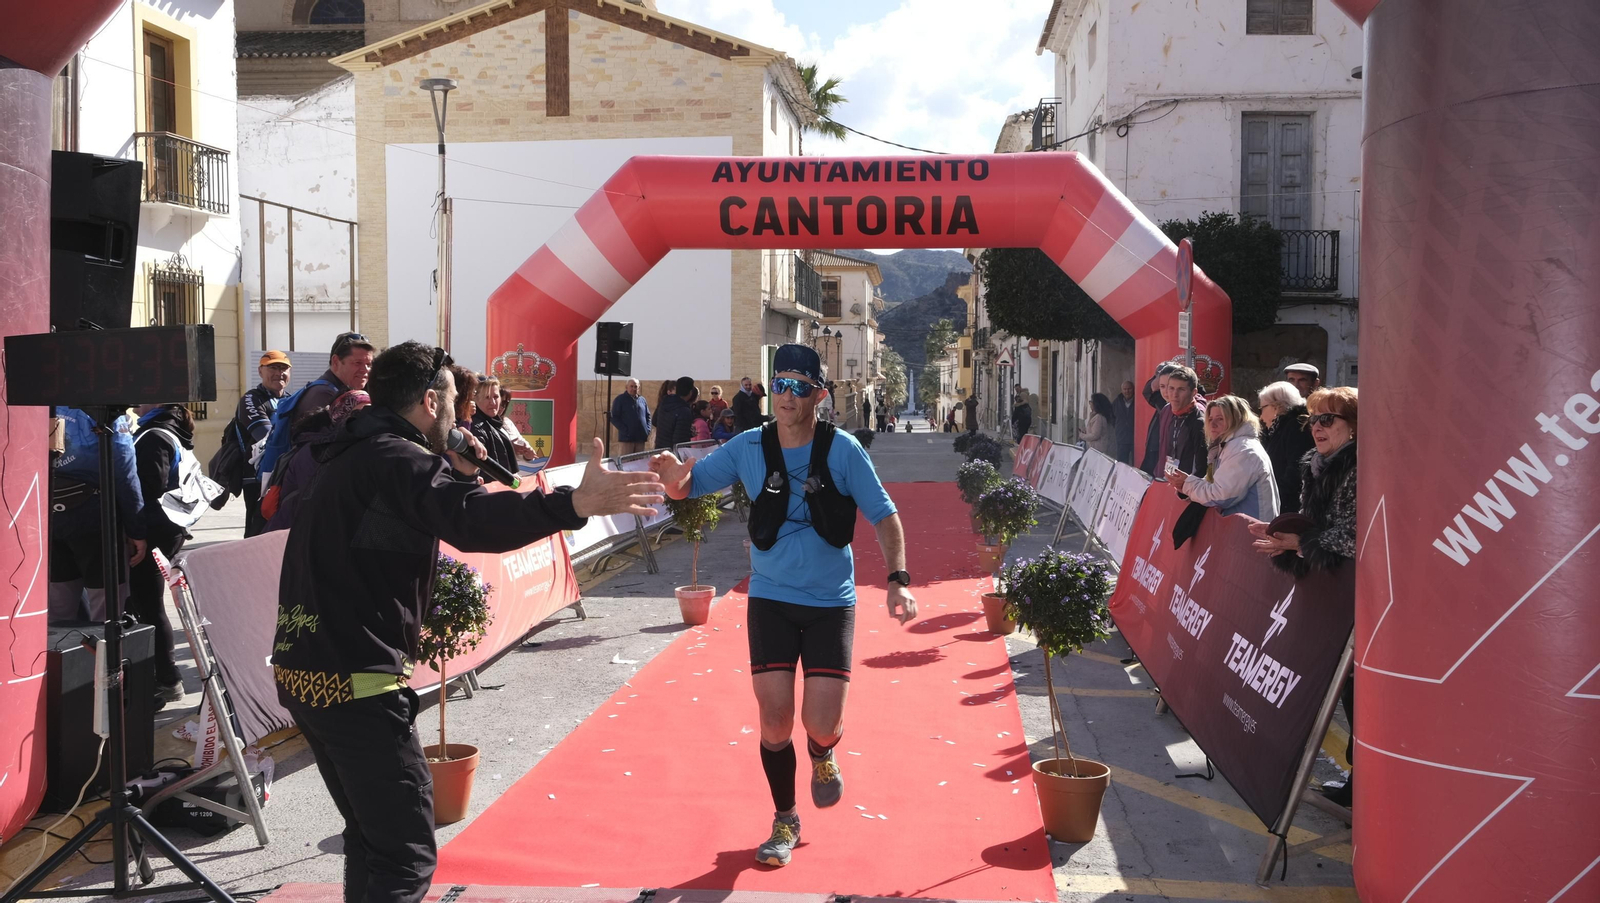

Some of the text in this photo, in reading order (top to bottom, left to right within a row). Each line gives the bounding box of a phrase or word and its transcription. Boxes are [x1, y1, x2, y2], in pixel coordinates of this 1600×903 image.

[711, 159, 989, 182] AYUNTAMIENTO
[719, 195, 980, 236] CANTORIA
[1168, 583, 1214, 640] TEAMERGY
[1223, 632, 1302, 709] TEAMERGY
